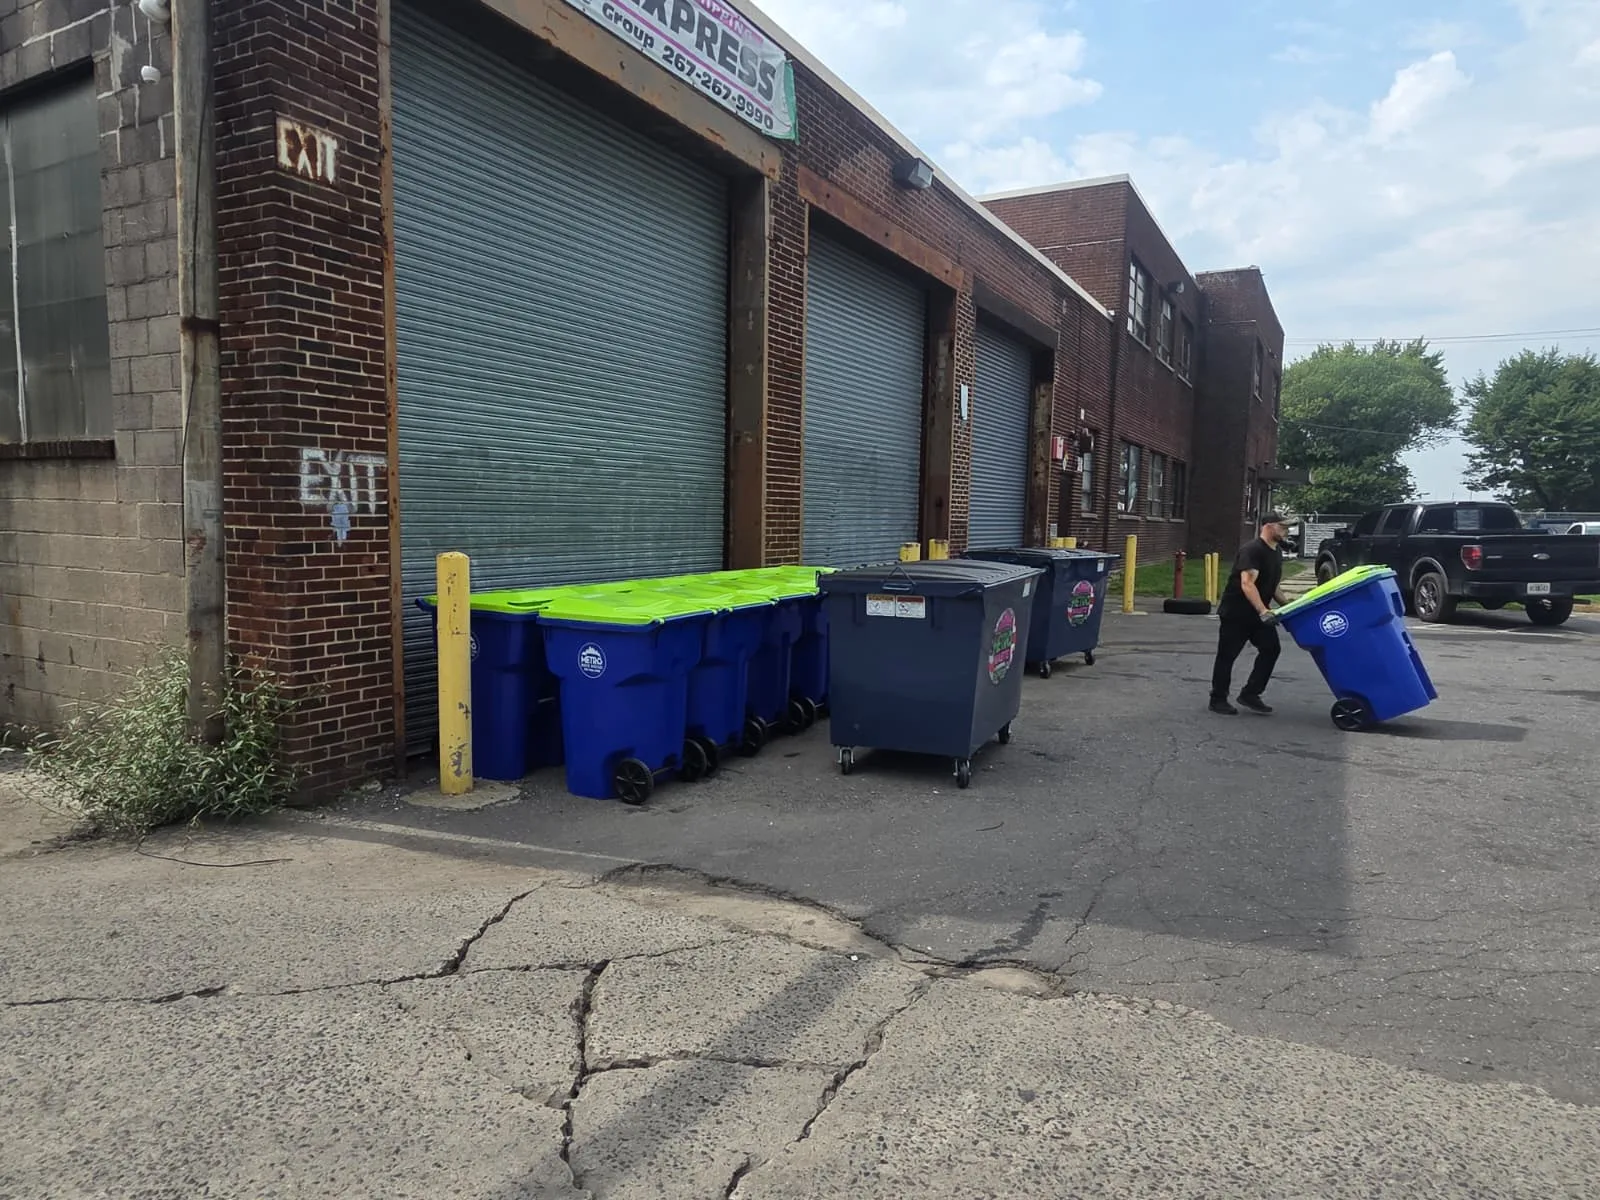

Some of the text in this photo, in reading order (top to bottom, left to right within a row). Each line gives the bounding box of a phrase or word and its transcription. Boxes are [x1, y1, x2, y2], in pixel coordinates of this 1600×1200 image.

[602, 3, 774, 130] Group 267-267-9990
[629, 0, 776, 101] XPRESS
[277, 117, 338, 184] EXIT
[300, 447, 387, 515] EXIT
[581, 656, 603, 665] METRO
